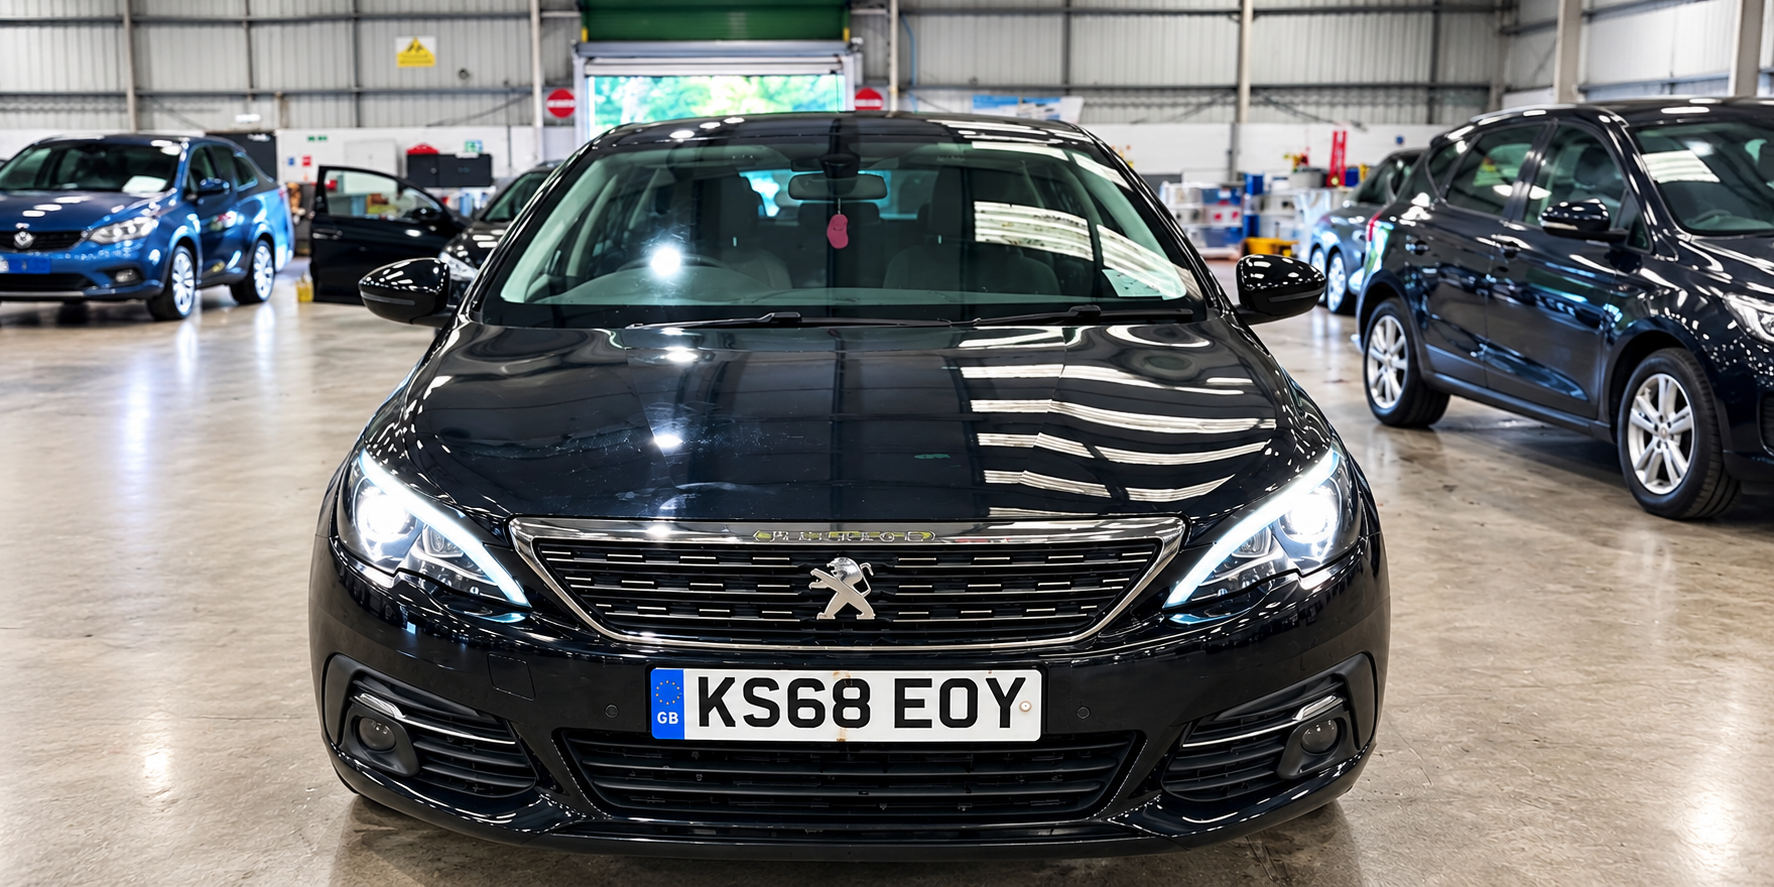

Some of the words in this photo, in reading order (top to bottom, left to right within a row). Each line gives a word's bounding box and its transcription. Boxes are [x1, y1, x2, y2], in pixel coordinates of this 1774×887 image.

[657, 712, 679, 725] GB
[698, 677, 871, 729] KS68
[894, 677, 1026, 729] EOY
